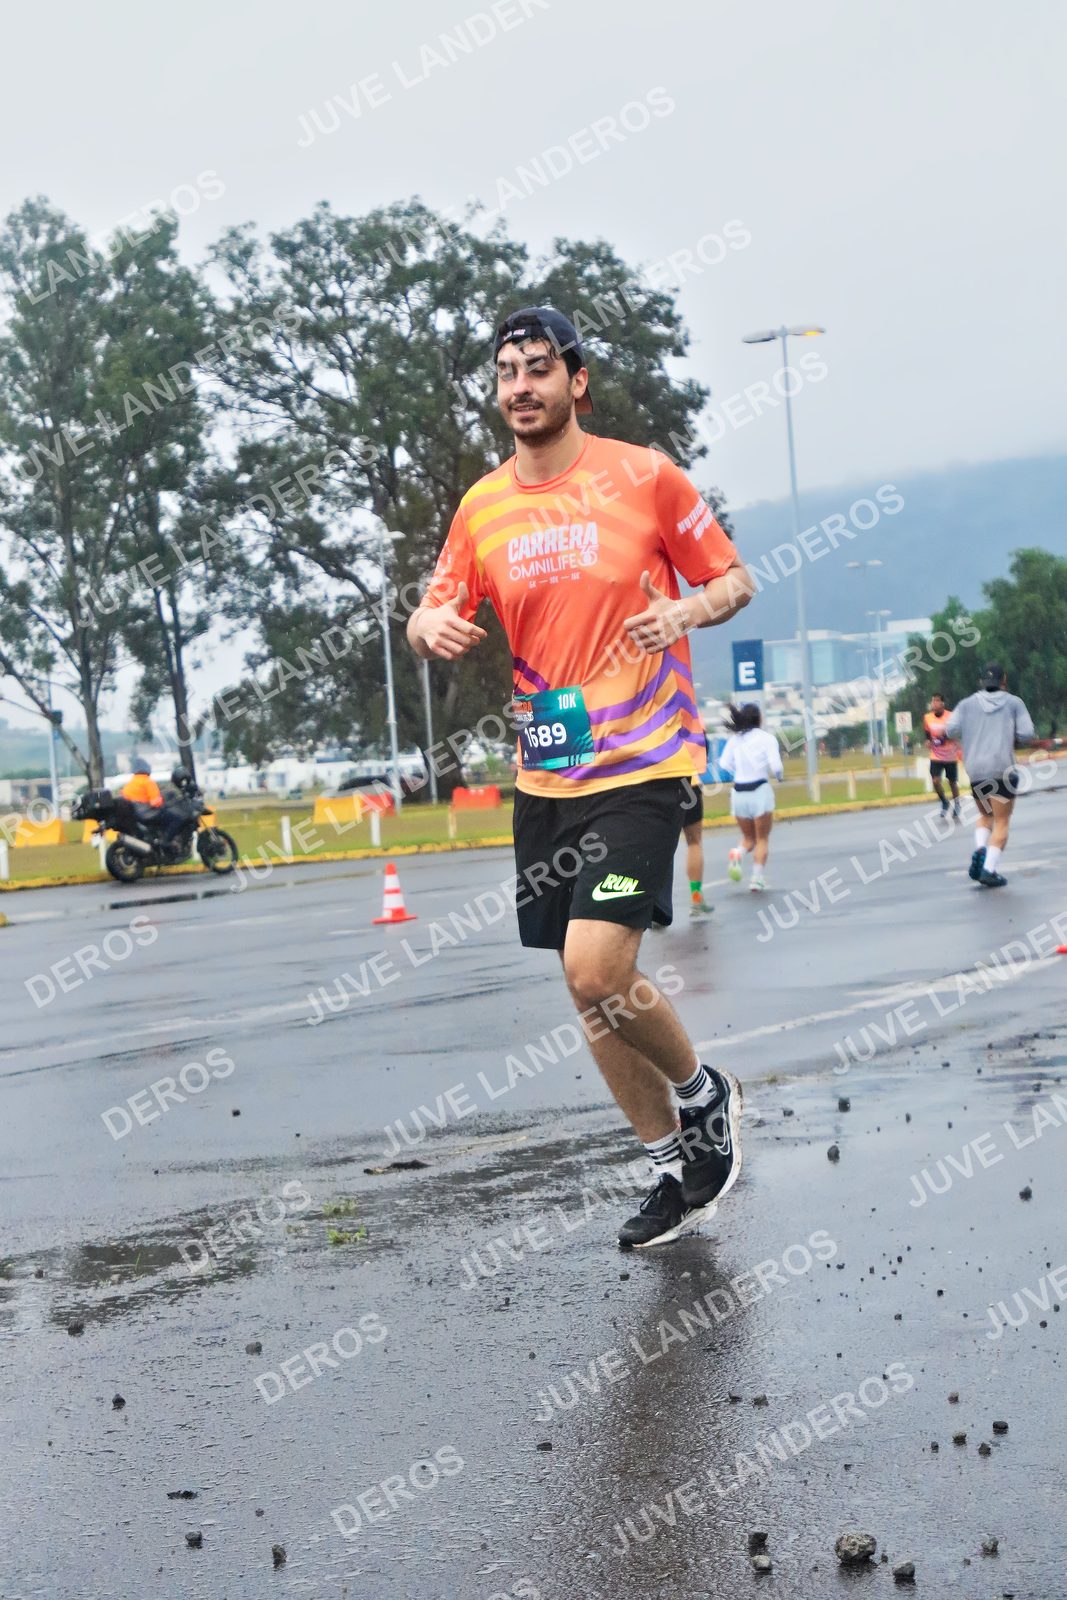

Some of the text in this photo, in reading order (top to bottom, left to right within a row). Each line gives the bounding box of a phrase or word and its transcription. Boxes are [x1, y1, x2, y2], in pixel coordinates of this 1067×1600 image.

[507, 521, 599, 563] CARRERA
[509, 553, 577, 581] OMNILIFE
[738, 661, 757, 686] E
[557, 692, 577, 710] 10K
[524, 722, 568, 748] 1689
[601, 873, 640, 892] RUN
